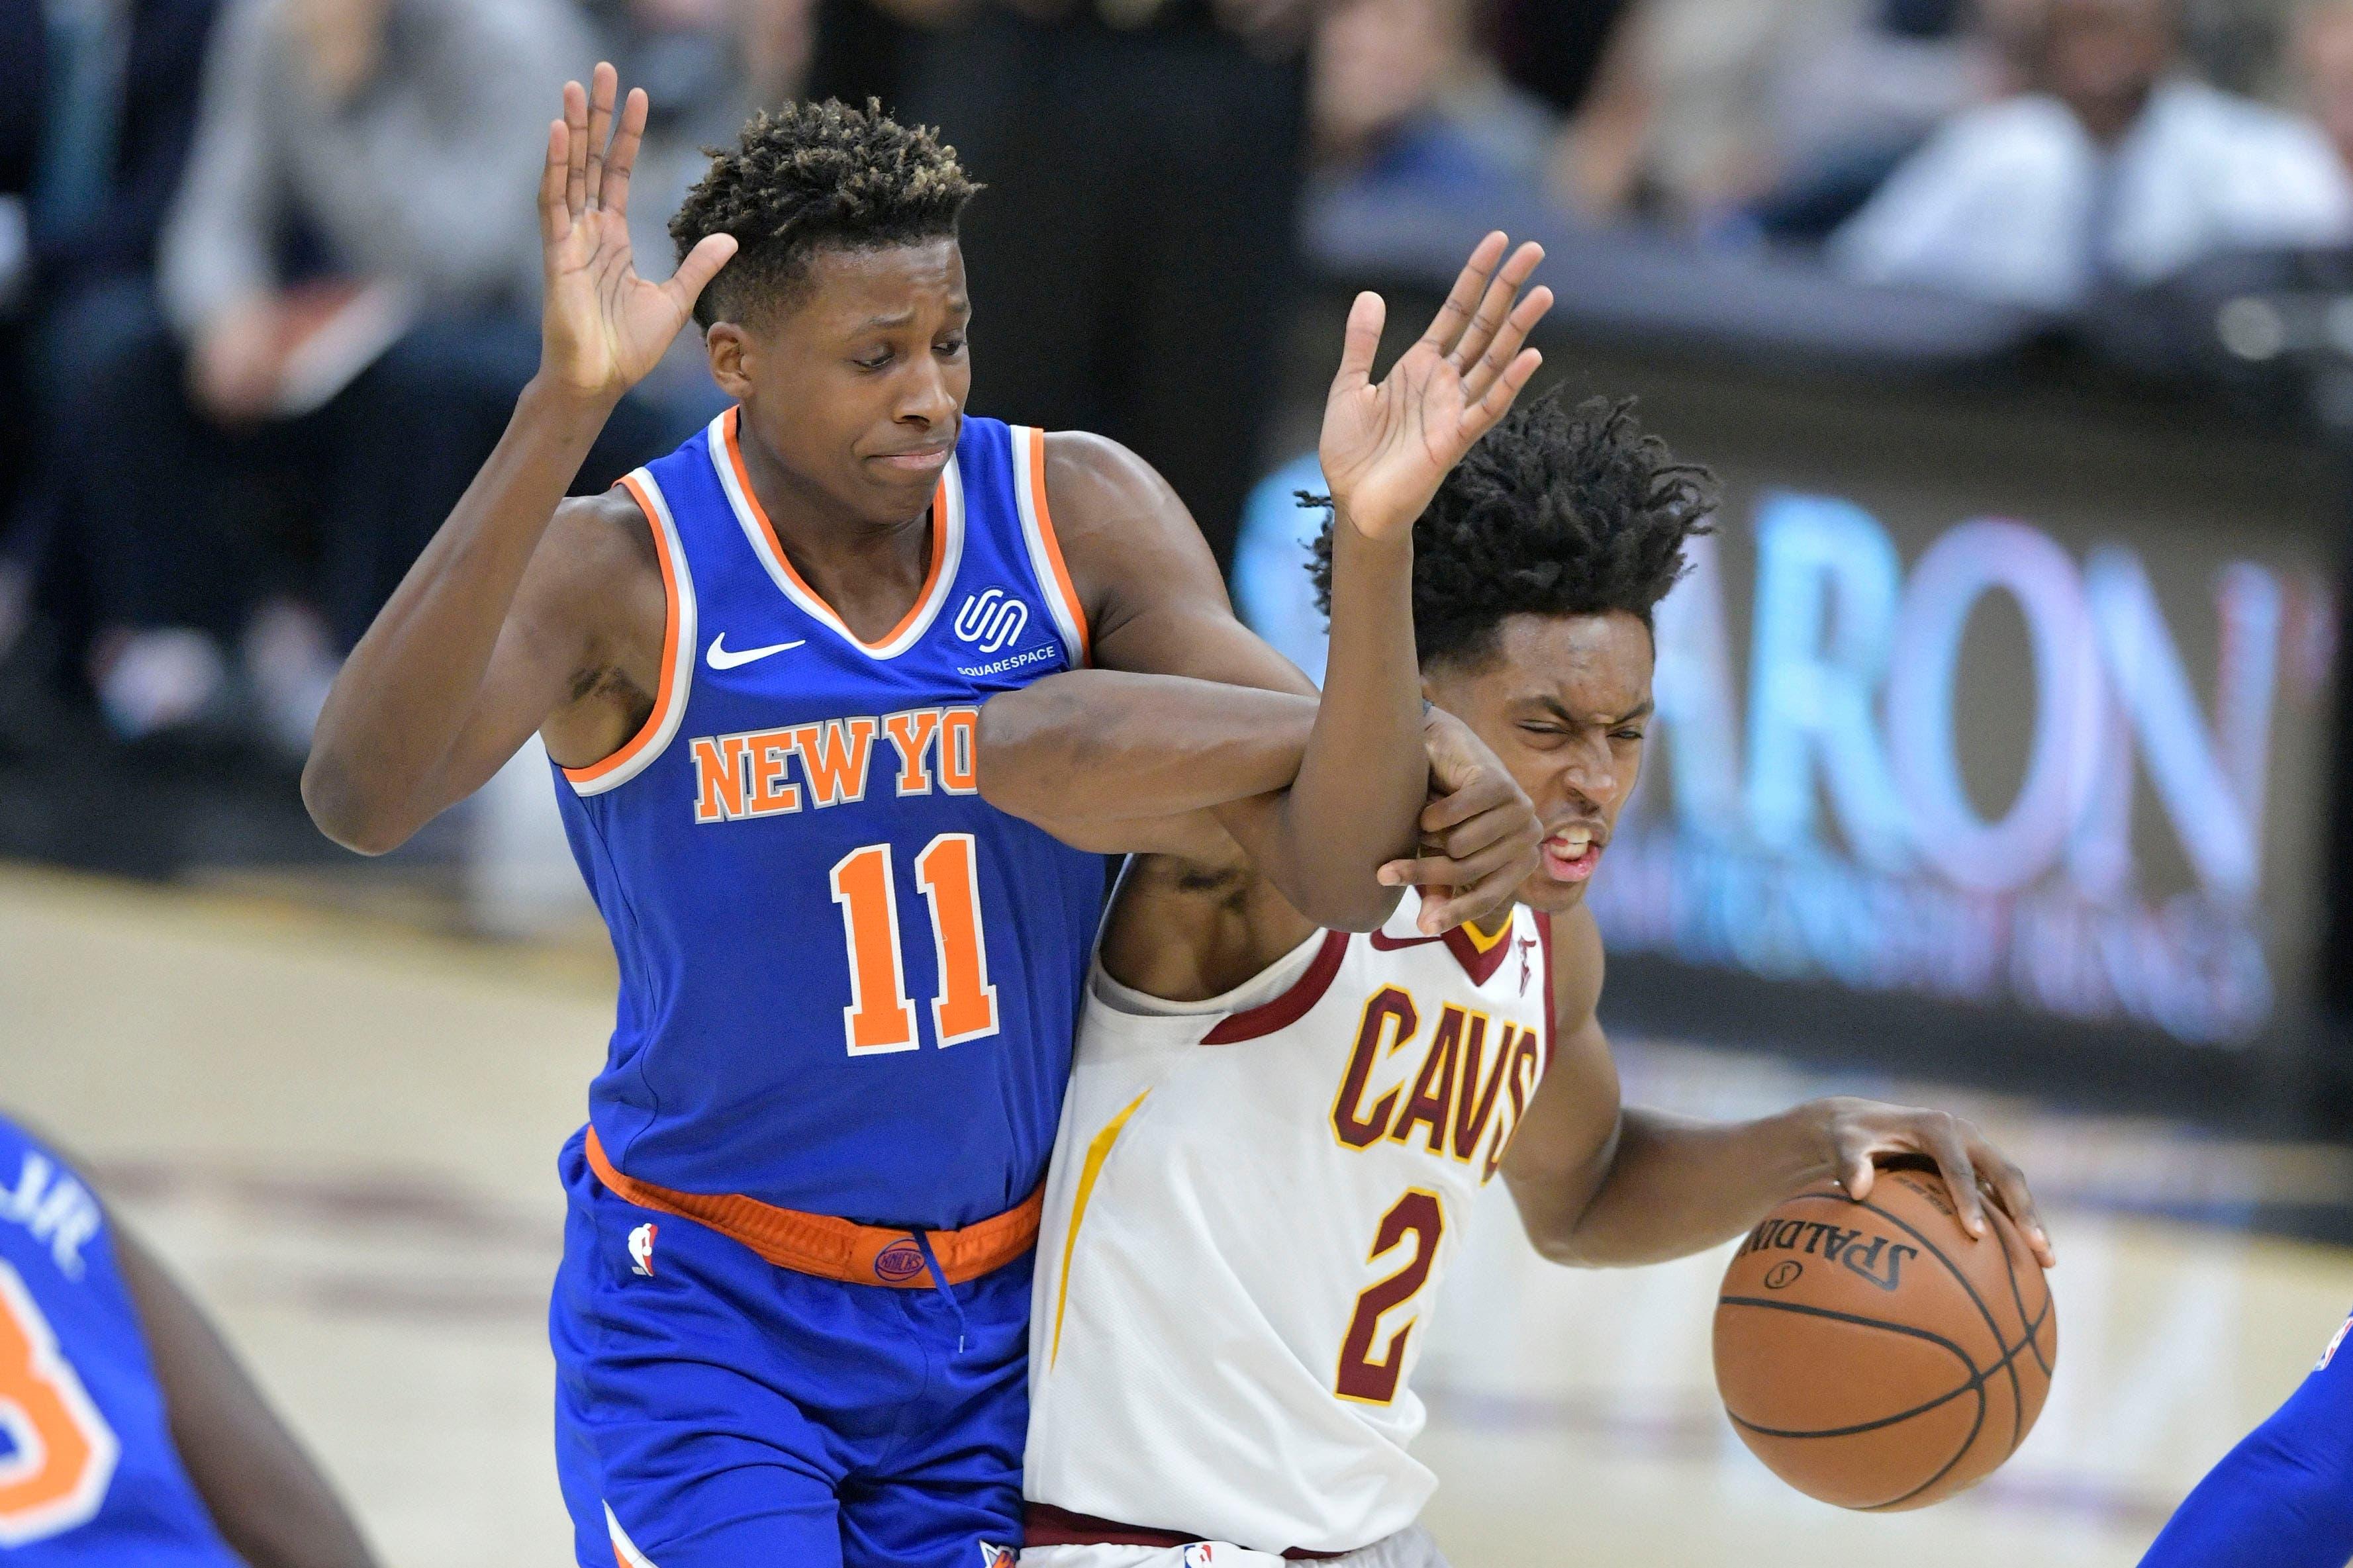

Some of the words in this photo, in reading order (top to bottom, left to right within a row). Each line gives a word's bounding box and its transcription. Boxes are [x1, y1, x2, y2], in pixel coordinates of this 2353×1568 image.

[956, 645, 1056, 677] SQUARESPACE
[689, 715, 880, 824] NEW
[830, 832, 1000, 1058] 11
[1329, 982, 1539, 1187] CAVS
[1334, 1185, 1445, 1407] 2
